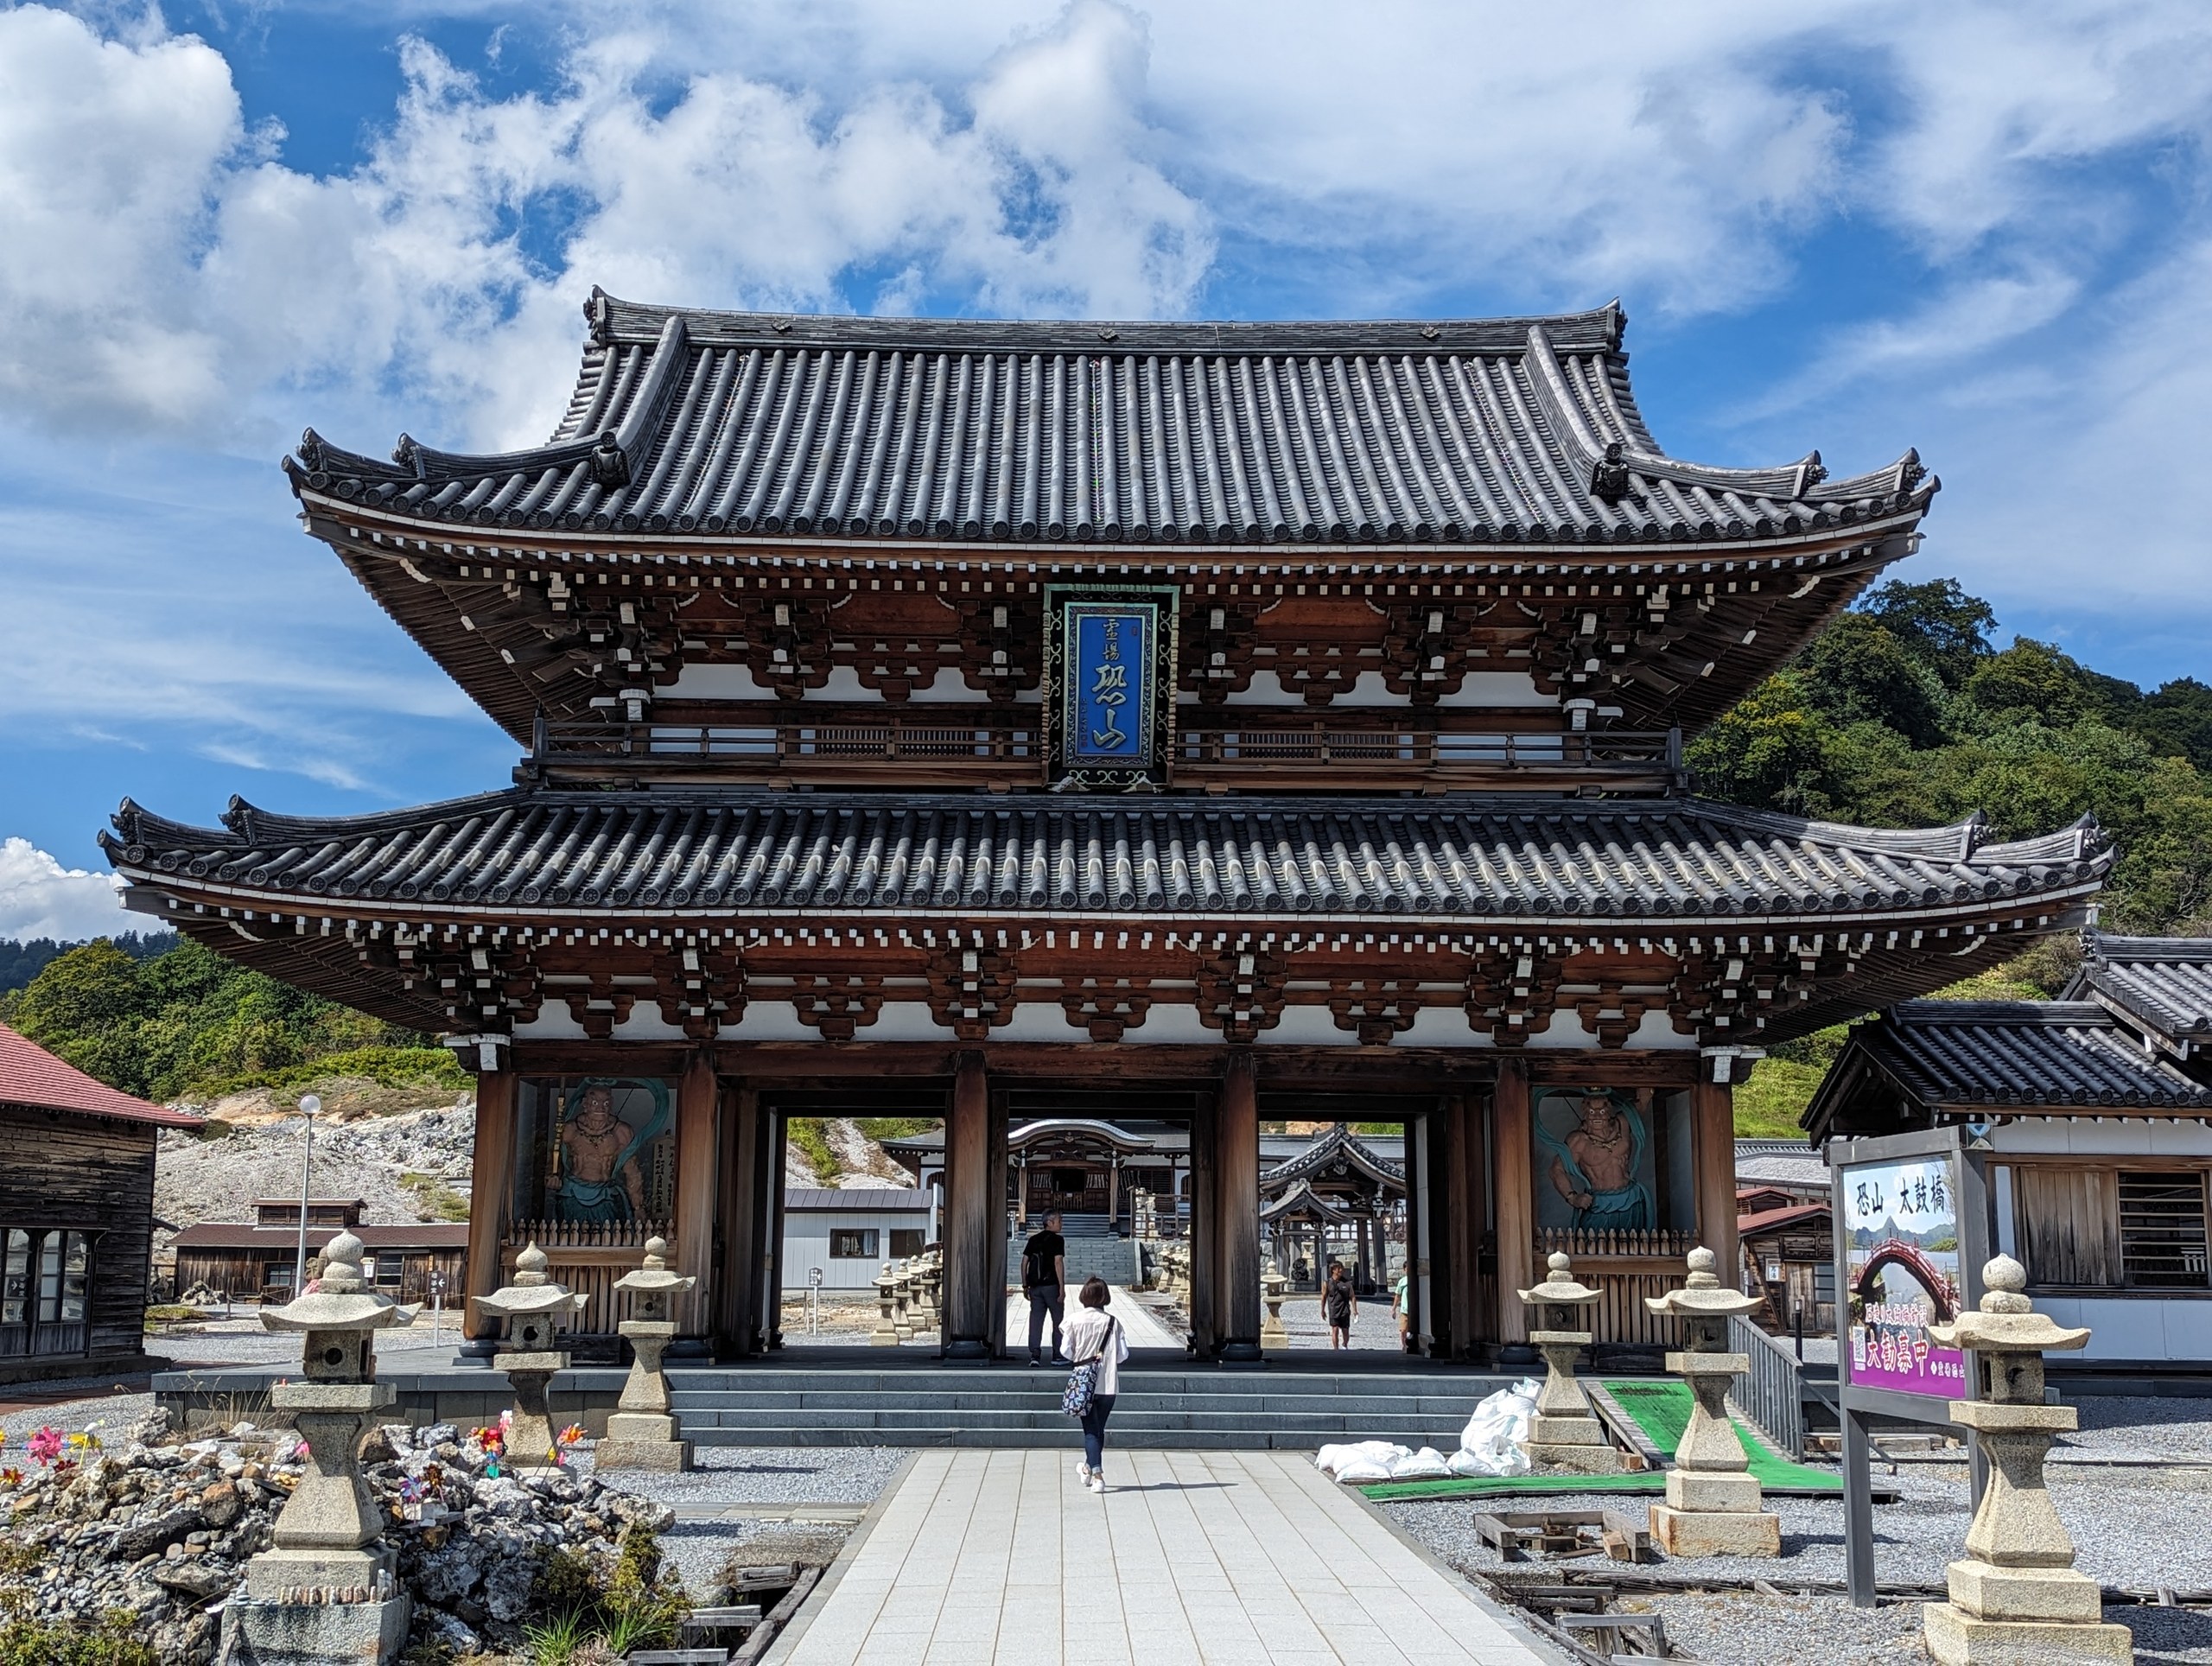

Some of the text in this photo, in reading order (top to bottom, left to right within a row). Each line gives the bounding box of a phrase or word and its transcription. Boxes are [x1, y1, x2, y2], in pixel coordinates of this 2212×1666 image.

[1857, 1174, 1944, 1216] 恐山 太鼓橋
[1866, 1328, 1929, 1377] 大勧募中
